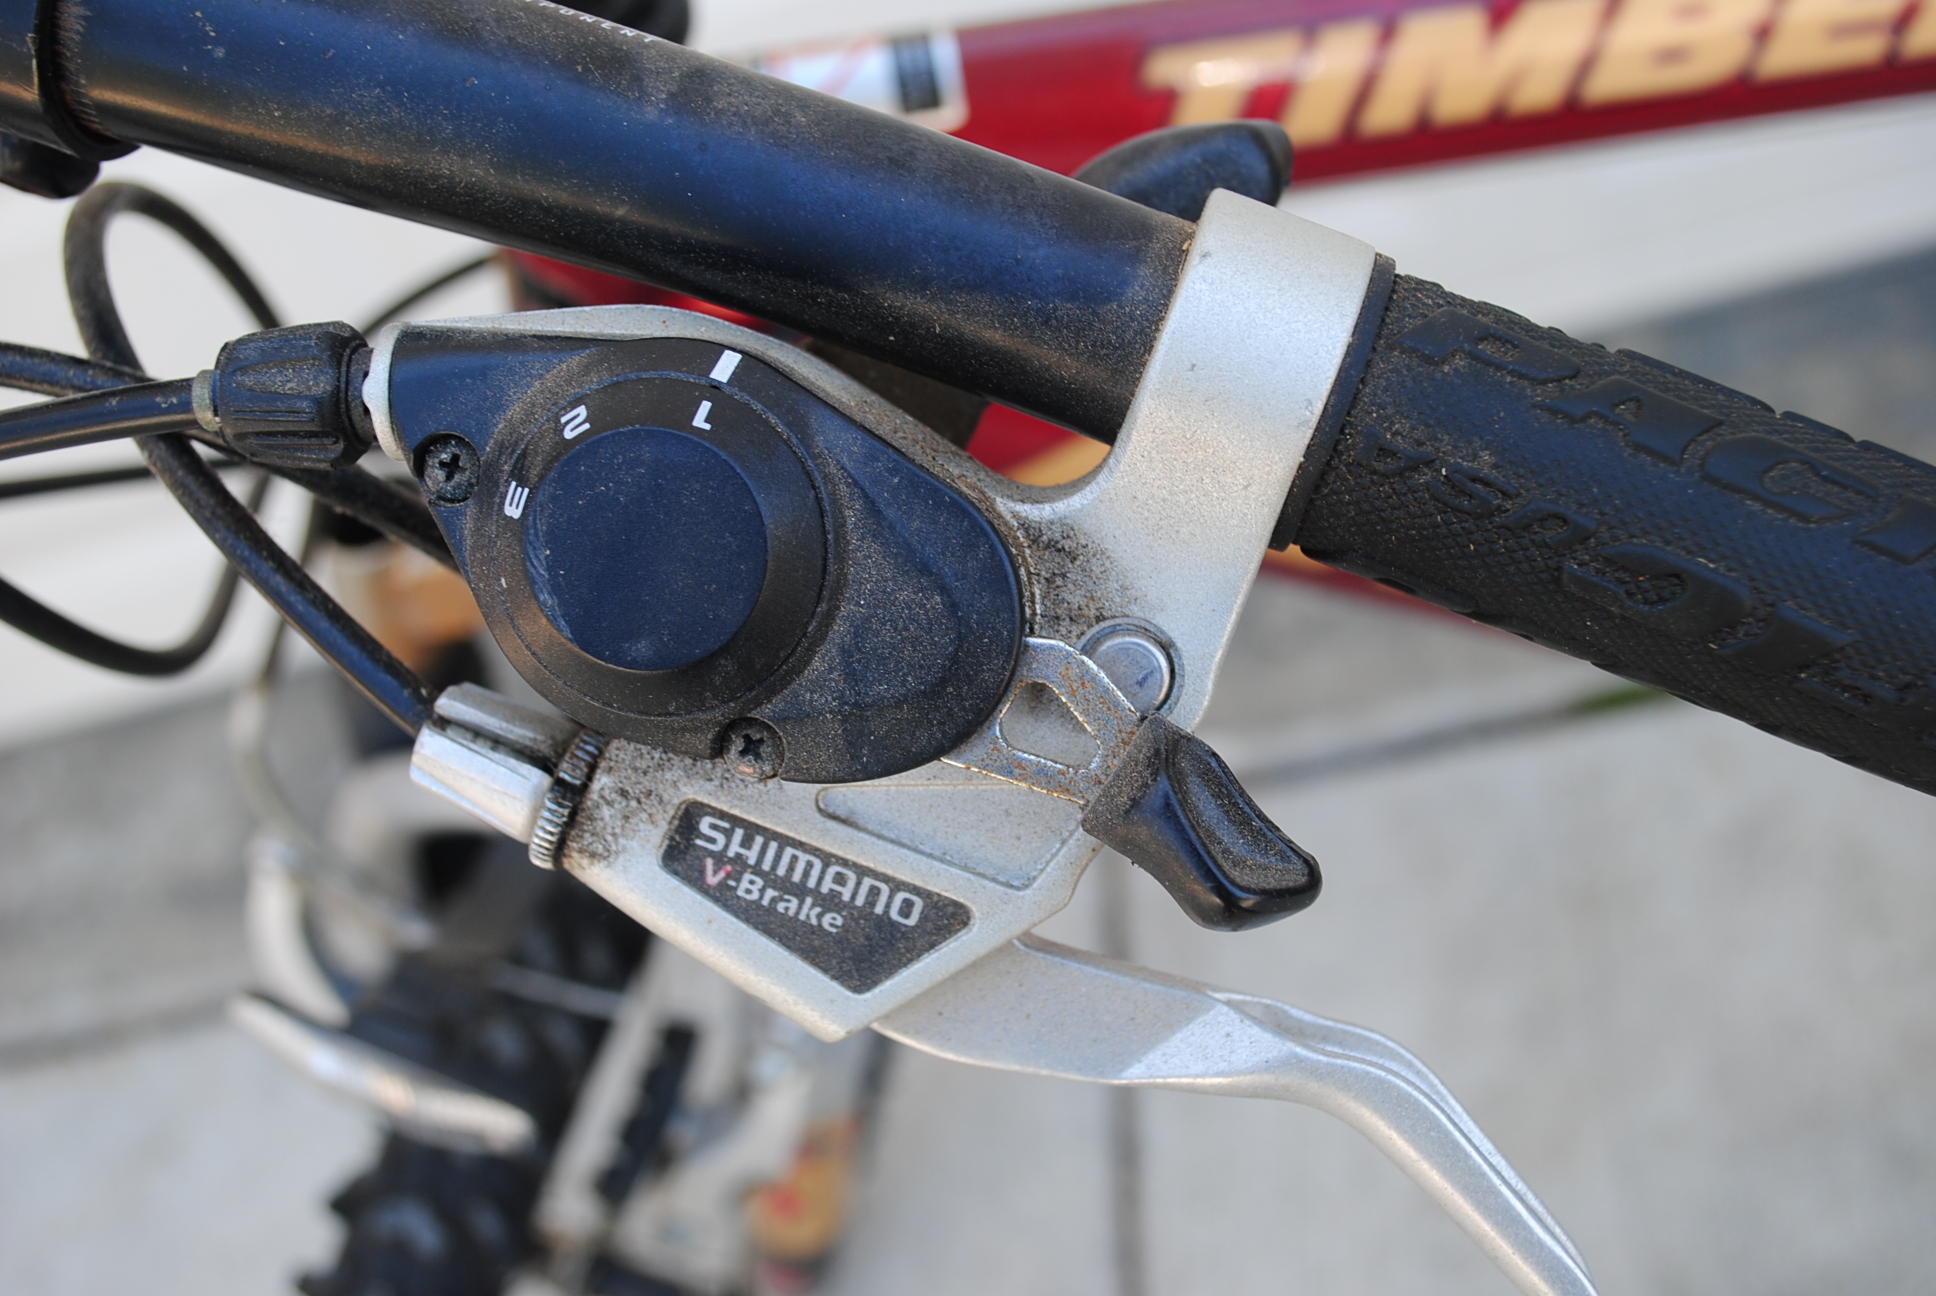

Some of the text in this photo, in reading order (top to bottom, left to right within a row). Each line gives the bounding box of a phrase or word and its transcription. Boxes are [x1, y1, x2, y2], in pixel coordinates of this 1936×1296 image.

[1140, 0, 1936, 150] TIMBE
[560, 404, 591, 440] 2
[503, 481, 529, 519] 3
[694, 815, 924, 928] SHIMANO
[704, 857, 844, 934] V-Brake
